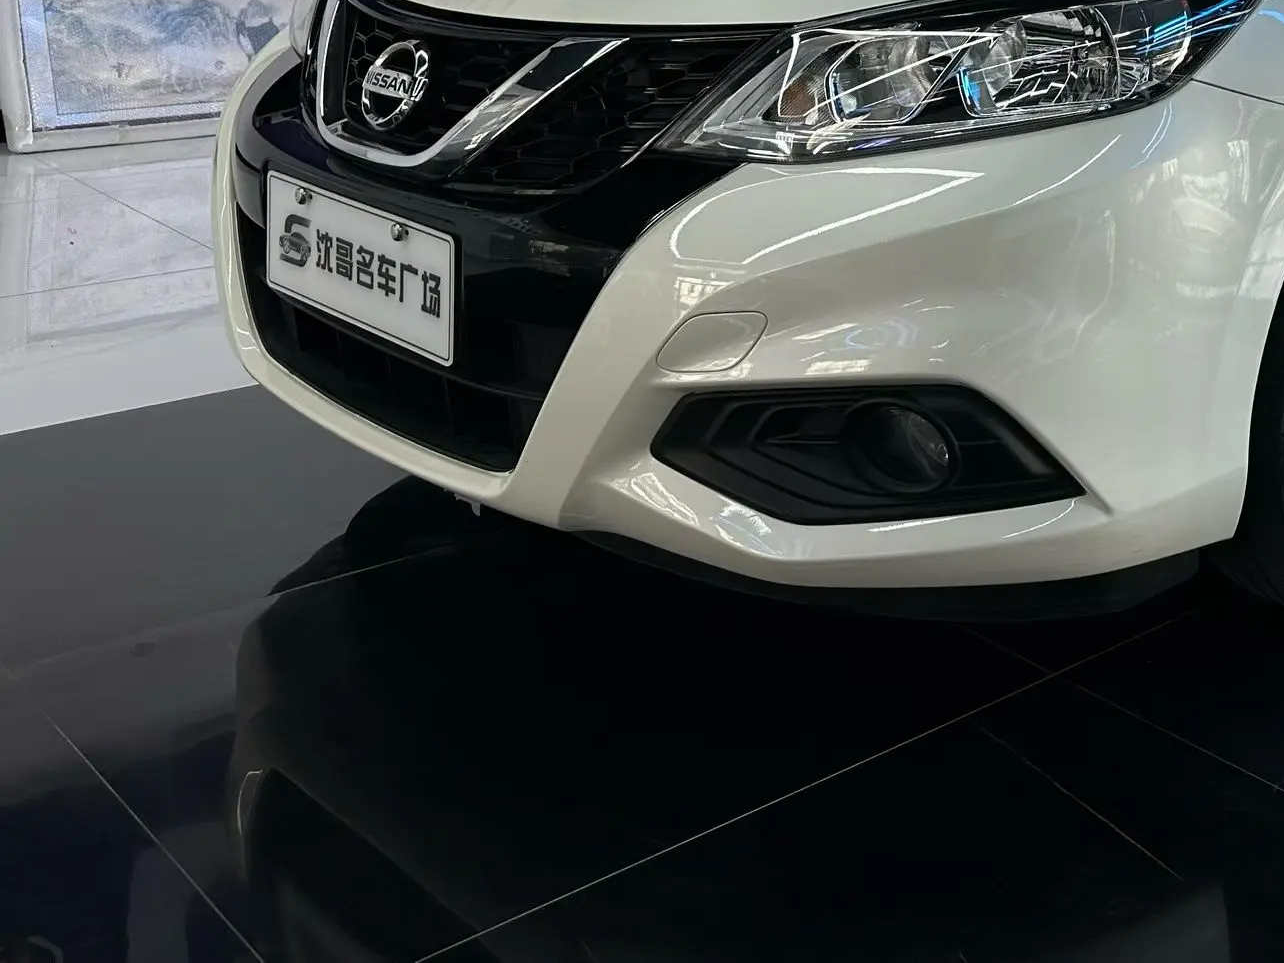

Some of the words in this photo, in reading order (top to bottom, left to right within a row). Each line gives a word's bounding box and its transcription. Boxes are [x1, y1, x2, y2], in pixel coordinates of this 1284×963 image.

[366, 69, 414, 95] NISSAN
[315, 228, 442, 319] 沈哥名车广场
